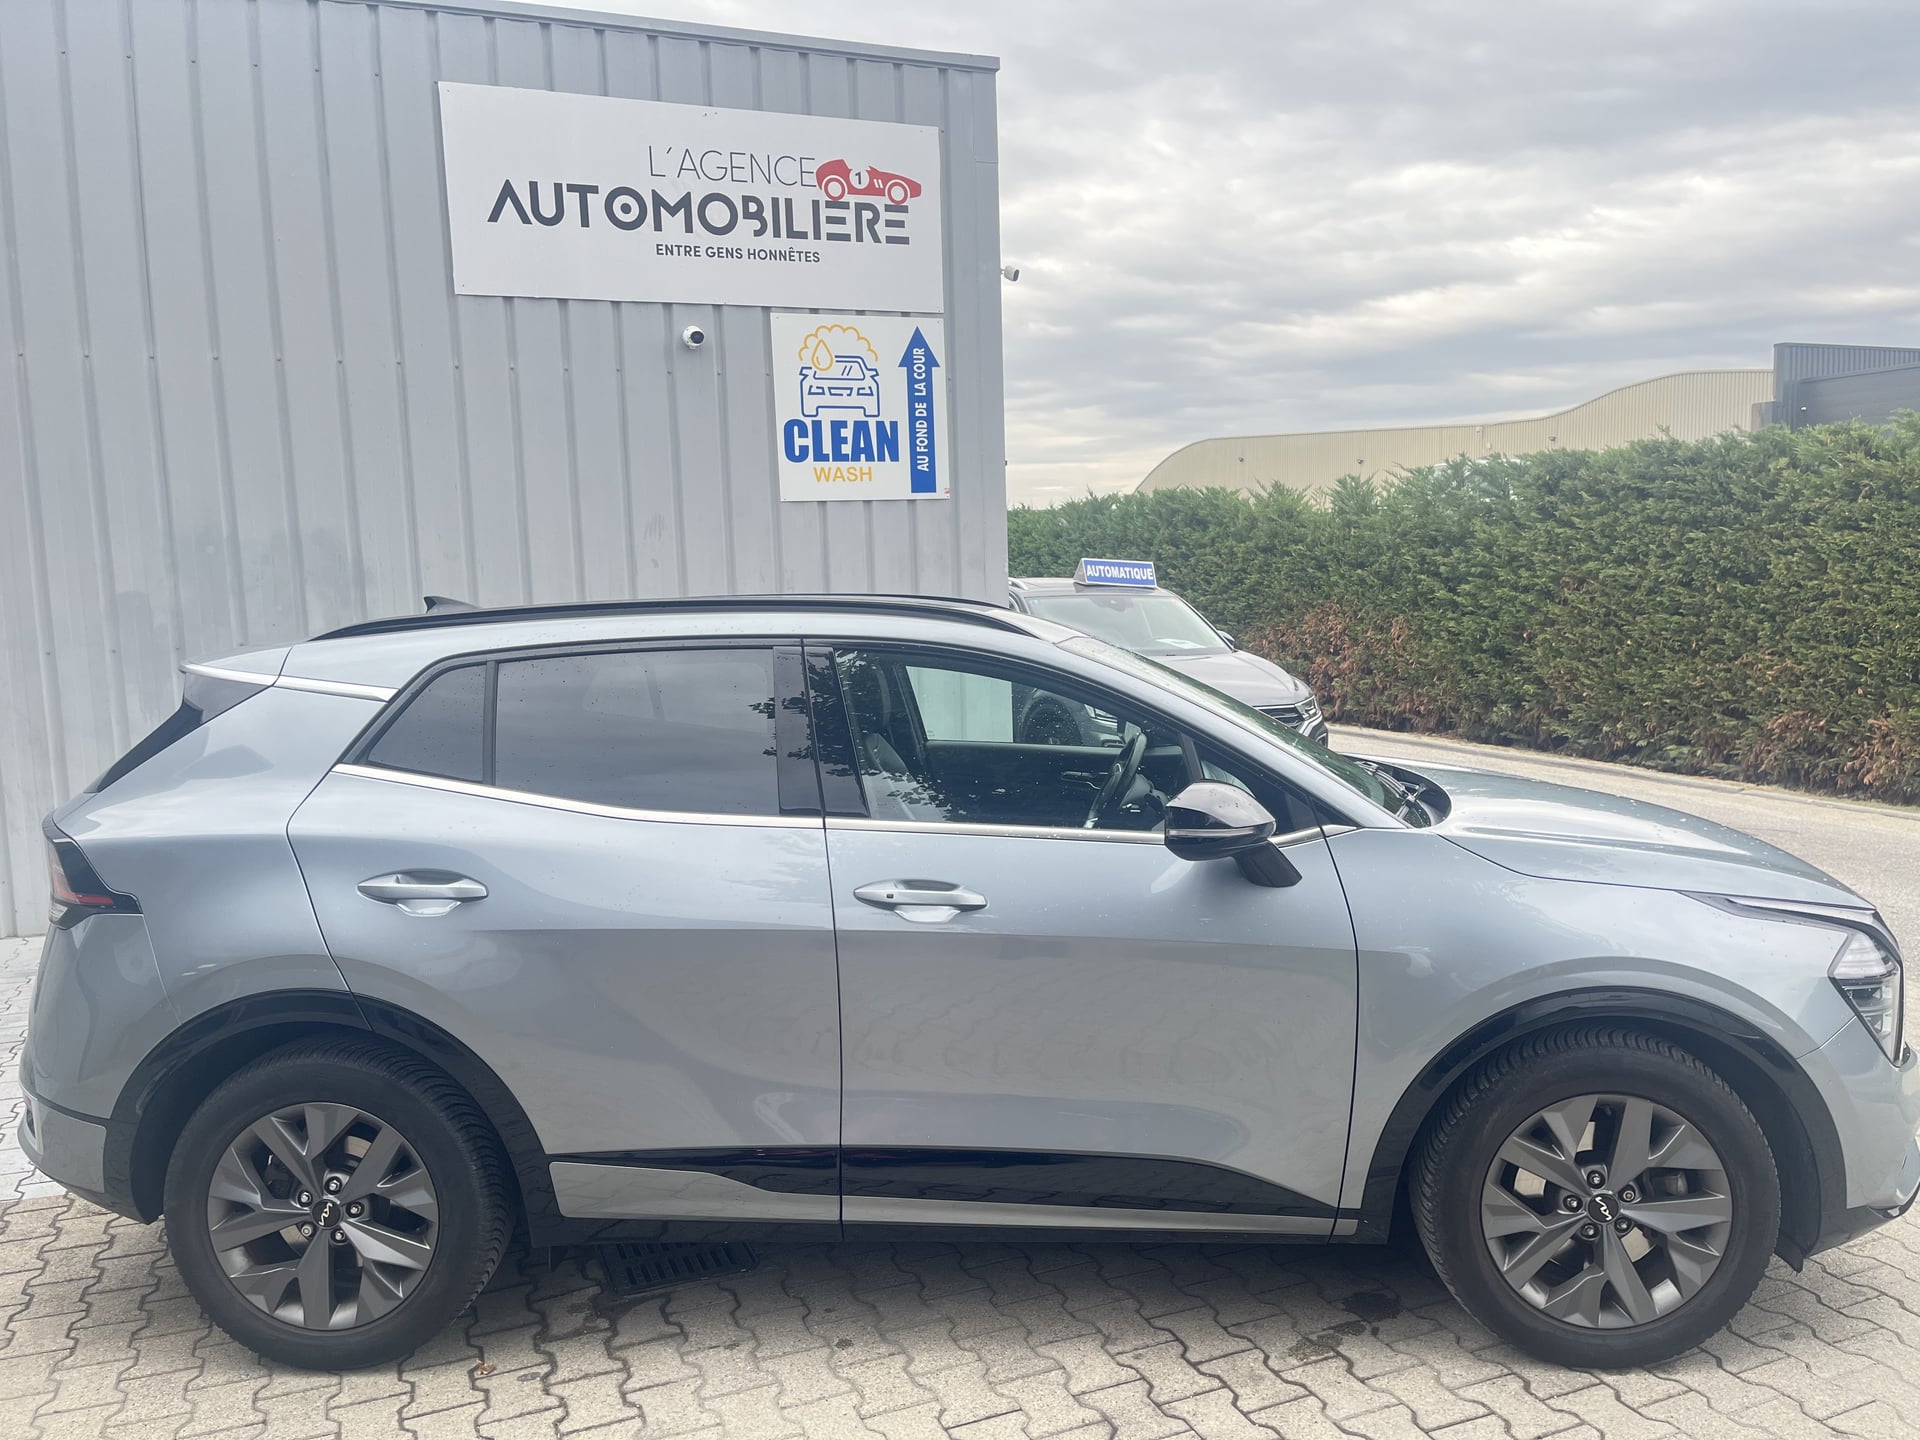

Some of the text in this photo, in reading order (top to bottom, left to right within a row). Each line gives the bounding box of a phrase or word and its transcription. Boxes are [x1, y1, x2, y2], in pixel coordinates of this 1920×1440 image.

[648, 145, 817, 188] L'AGENCE
[854, 171, 862, 185] 1
[655, 243, 821, 264] ENTRE GENS HONNÊTES
[912, 347, 930, 472] AU FOND DE LA COUR
[783, 418, 900, 463] CLEAN
[813, 466, 873, 482] WASH
[1086, 565, 1154, 580] AUTOMATIQUE
